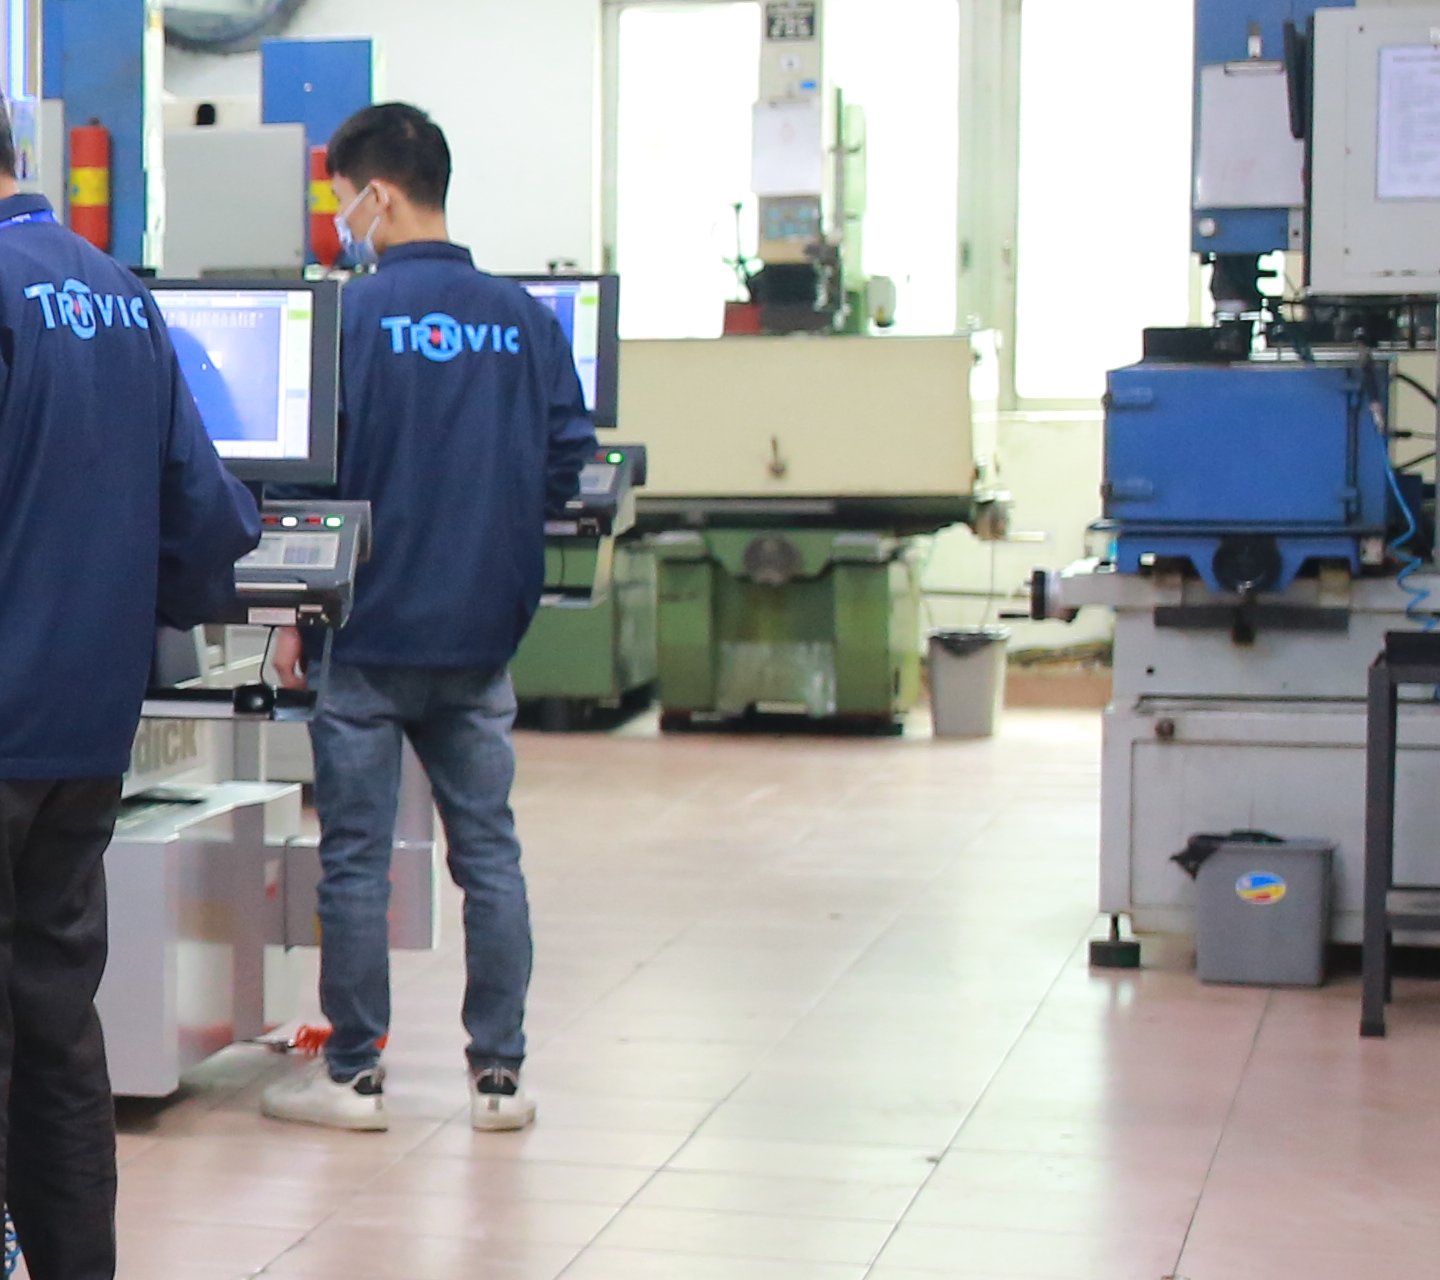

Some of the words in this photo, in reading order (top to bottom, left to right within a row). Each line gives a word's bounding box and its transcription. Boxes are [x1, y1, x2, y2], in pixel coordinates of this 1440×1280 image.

[23, 277, 149, 340] TRONVIC
[380, 311, 520, 363] TRONVIC
[133, 719, 198, 774] dick
